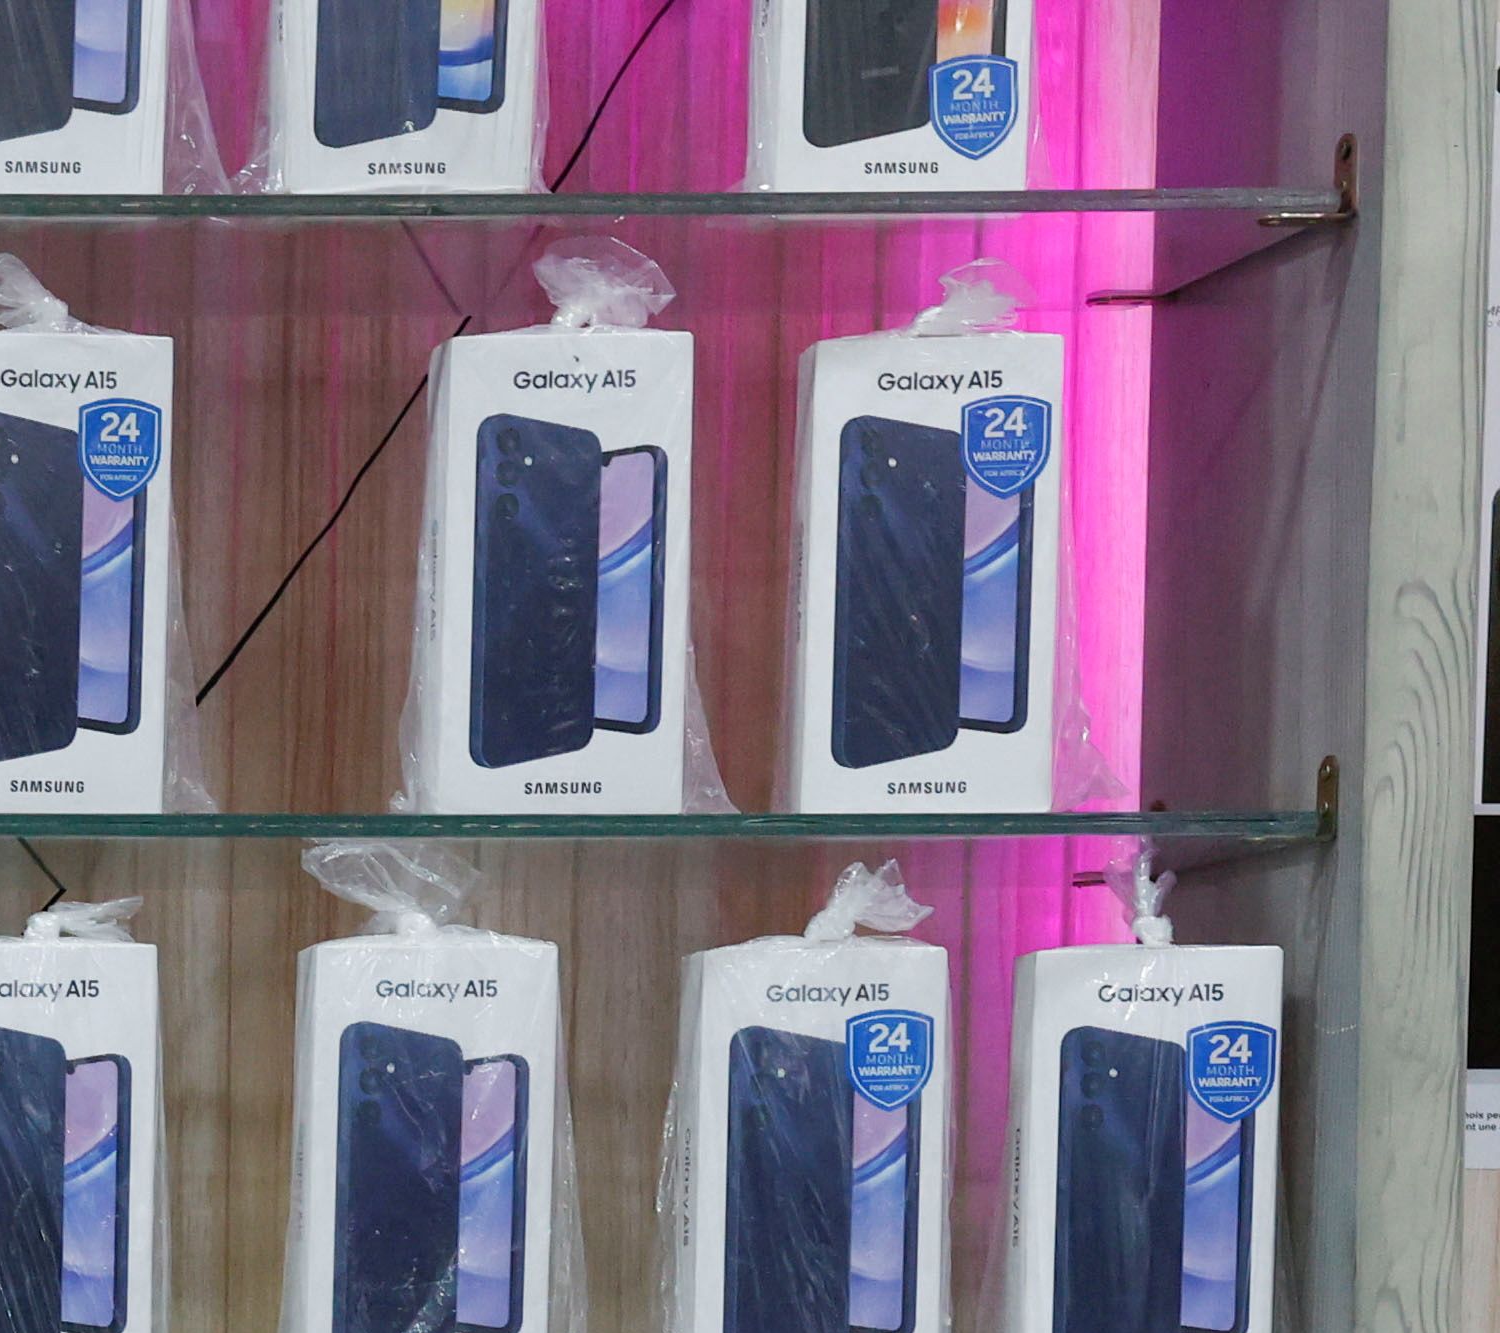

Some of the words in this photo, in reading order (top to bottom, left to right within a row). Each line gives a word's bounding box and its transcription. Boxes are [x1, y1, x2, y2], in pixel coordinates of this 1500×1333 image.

[952, 68, 995, 98] 24
[950, 100, 998, 112] MONTH
[942, 112, 1005, 126] WARRANTY
[368, 162, 446, 176] SAMSUNG
[513, 370, 597, 394] Galaxy
[602, 370, 636, 388] A15
[972, 452, 1036, 465] WARRANTY
[66, 980, 99, 998] A15
[1098, 984, 1184, 1006] Galaxy
[1190, 984, 1224, 1002] A15
[1208, 1034, 1252, 1064] 24
[1206, 1064, 1255, 1077] MONTH
[1198, 1076, 1262, 1090] WARRANTY
